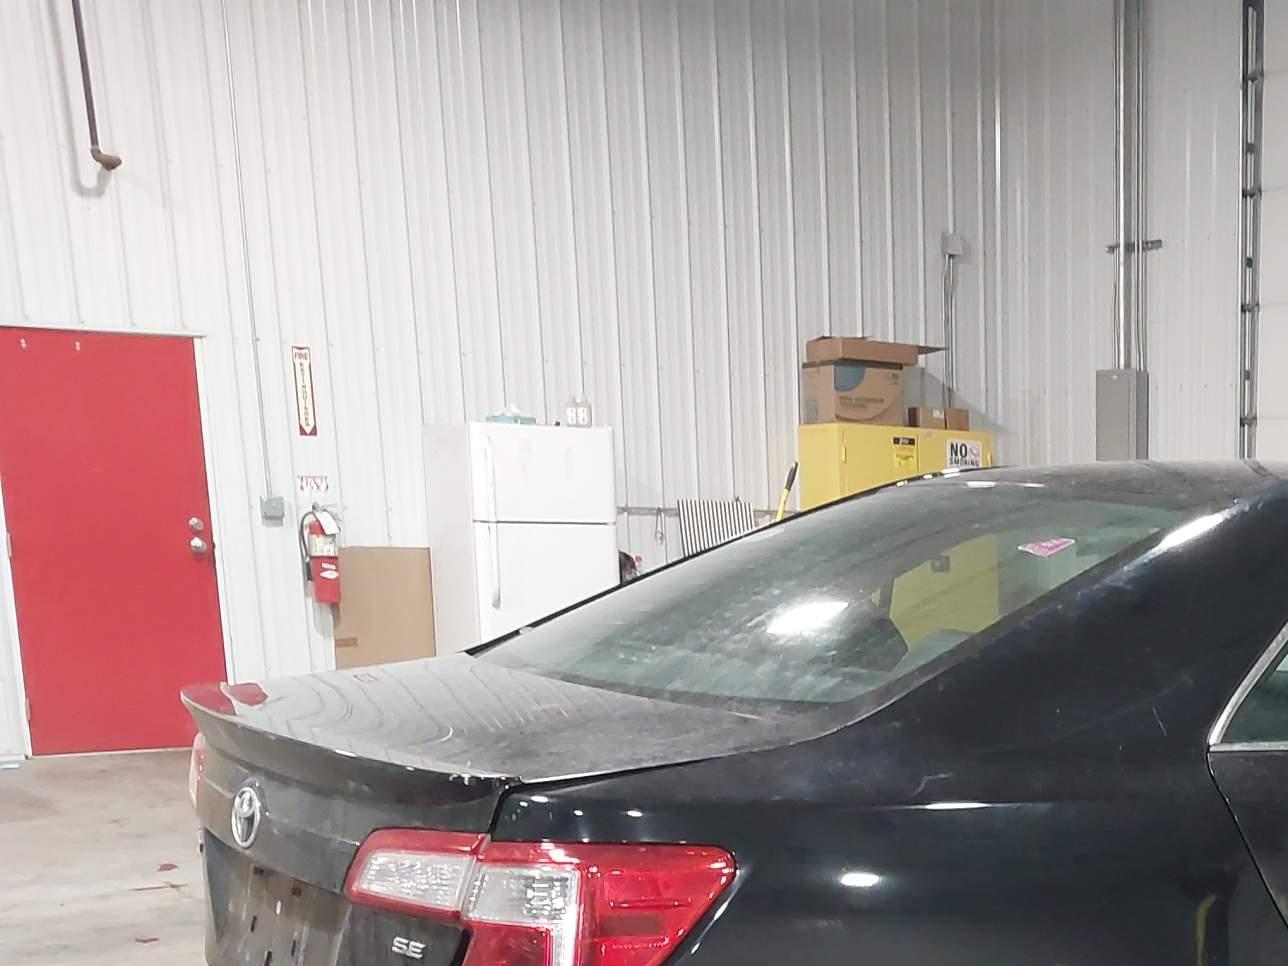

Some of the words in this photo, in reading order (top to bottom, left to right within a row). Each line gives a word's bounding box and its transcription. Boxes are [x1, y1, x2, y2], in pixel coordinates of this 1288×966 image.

[950, 442, 968, 458] NO
[949, 456, 979, 467] SMOKING
[391, 936, 426, 960] SE
